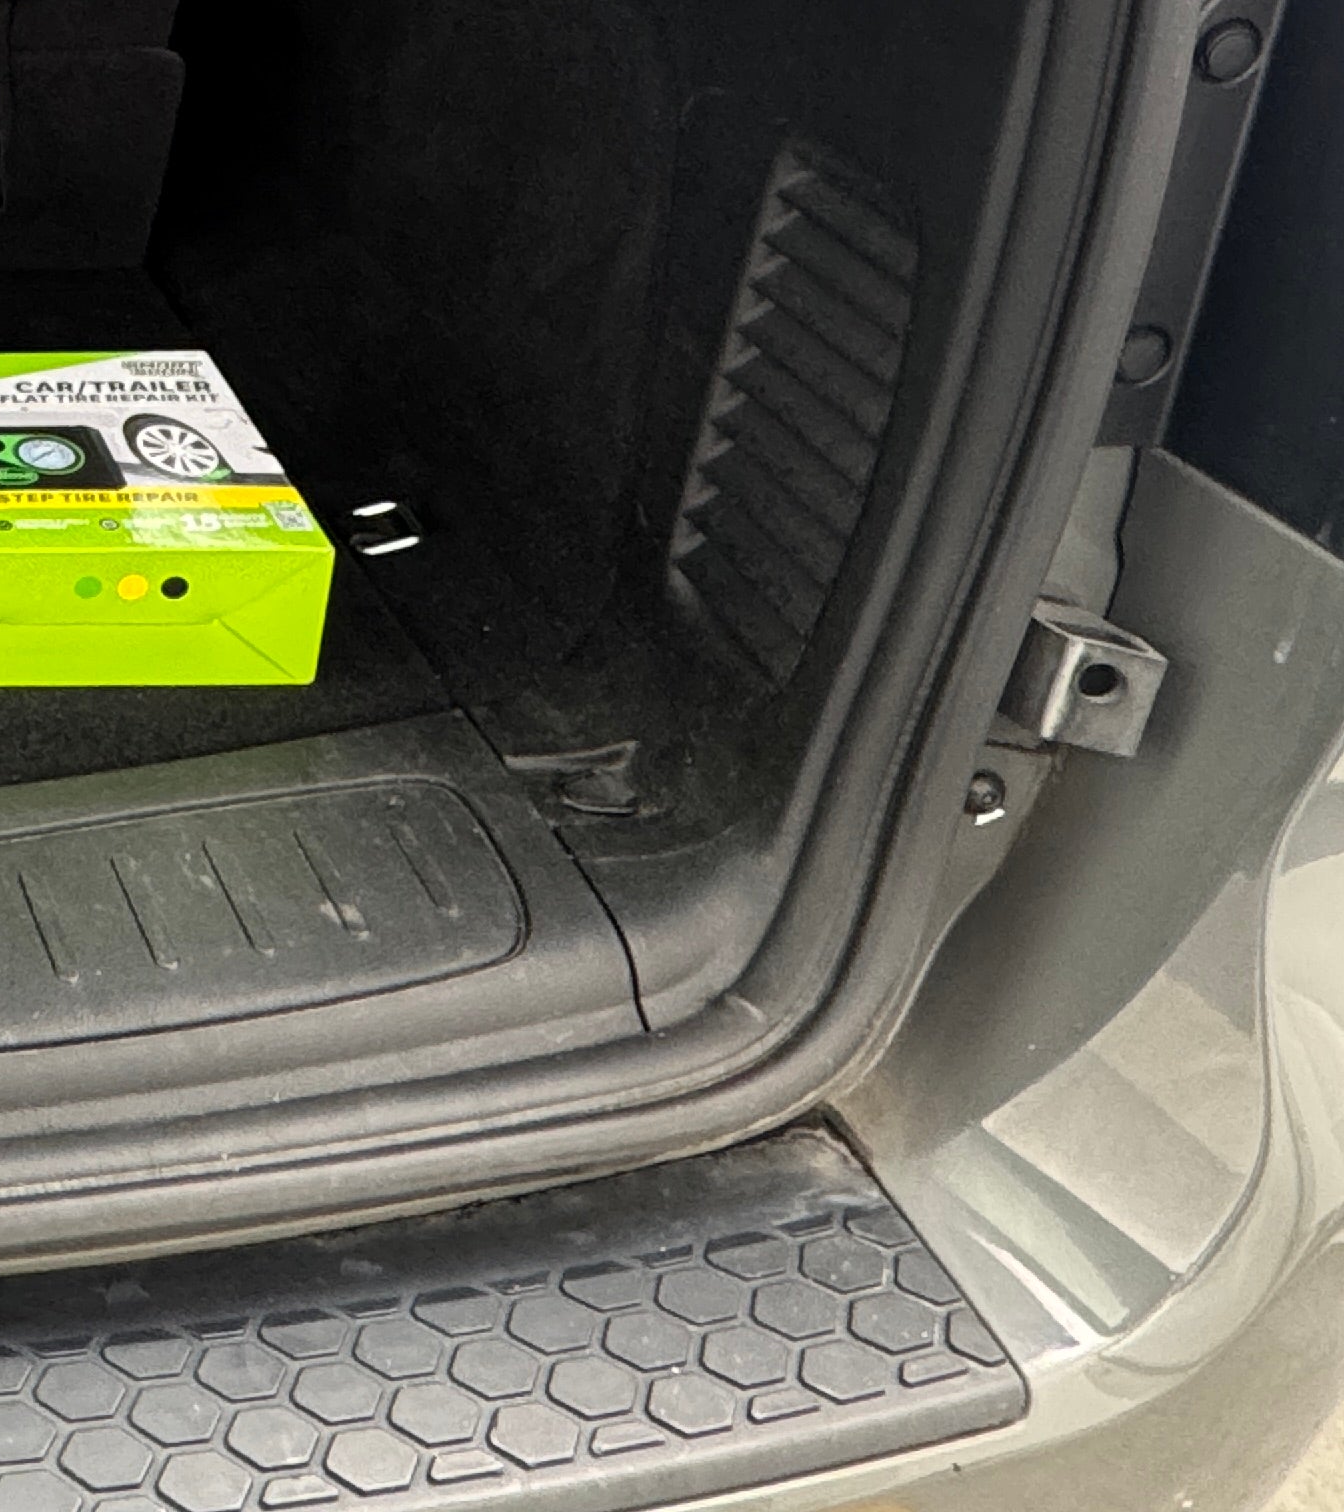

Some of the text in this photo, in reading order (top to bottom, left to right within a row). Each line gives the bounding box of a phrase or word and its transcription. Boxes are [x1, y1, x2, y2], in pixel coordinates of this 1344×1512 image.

[16, 381, 211, 396] CAR/TRAILER
[0, 393, 219, 403] FLAT TIRE REPAIR KIT
[58, 493, 112, 503] TIRE
[116, 492, 200, 503] REPAIR
